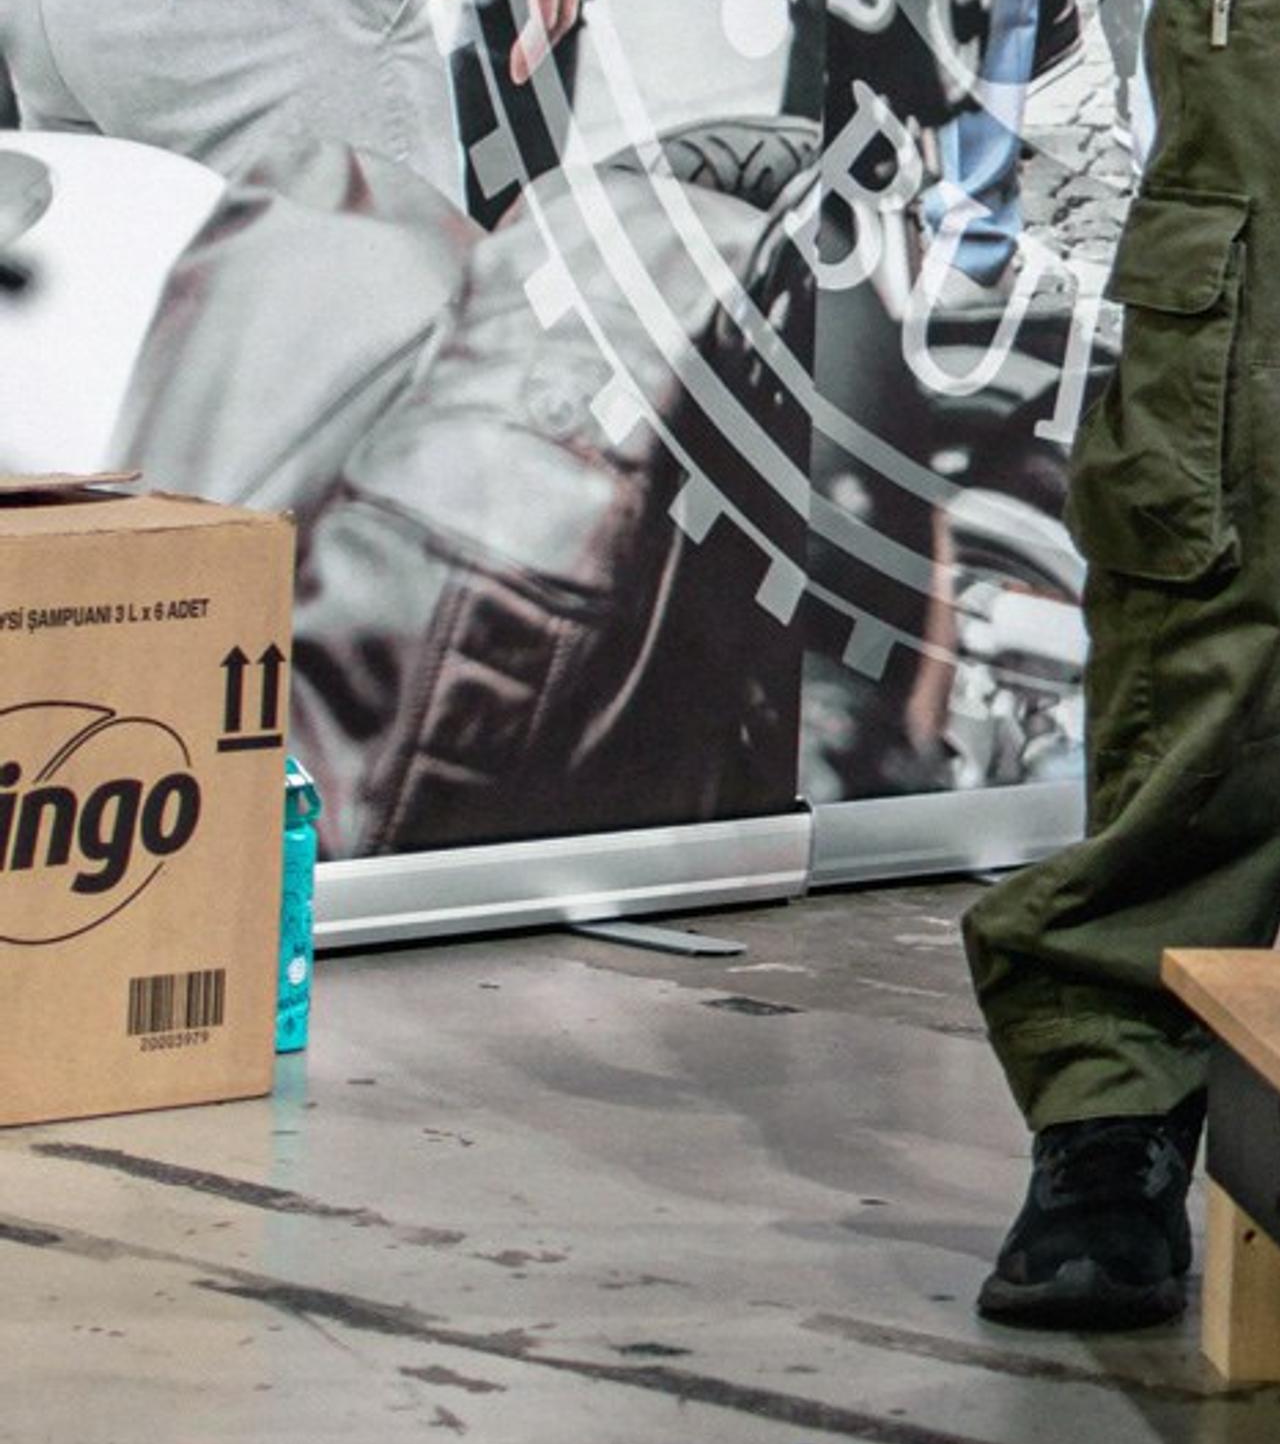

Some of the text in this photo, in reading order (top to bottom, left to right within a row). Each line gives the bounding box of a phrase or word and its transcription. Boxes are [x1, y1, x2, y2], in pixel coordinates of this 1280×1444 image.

[114, 604, 125, 623] 3
[128, 603, 138, 623] L
[154, 601, 164, 621] 6
[167, 598, 210, 620] ADET
[0, 760, 202, 895] ingo
